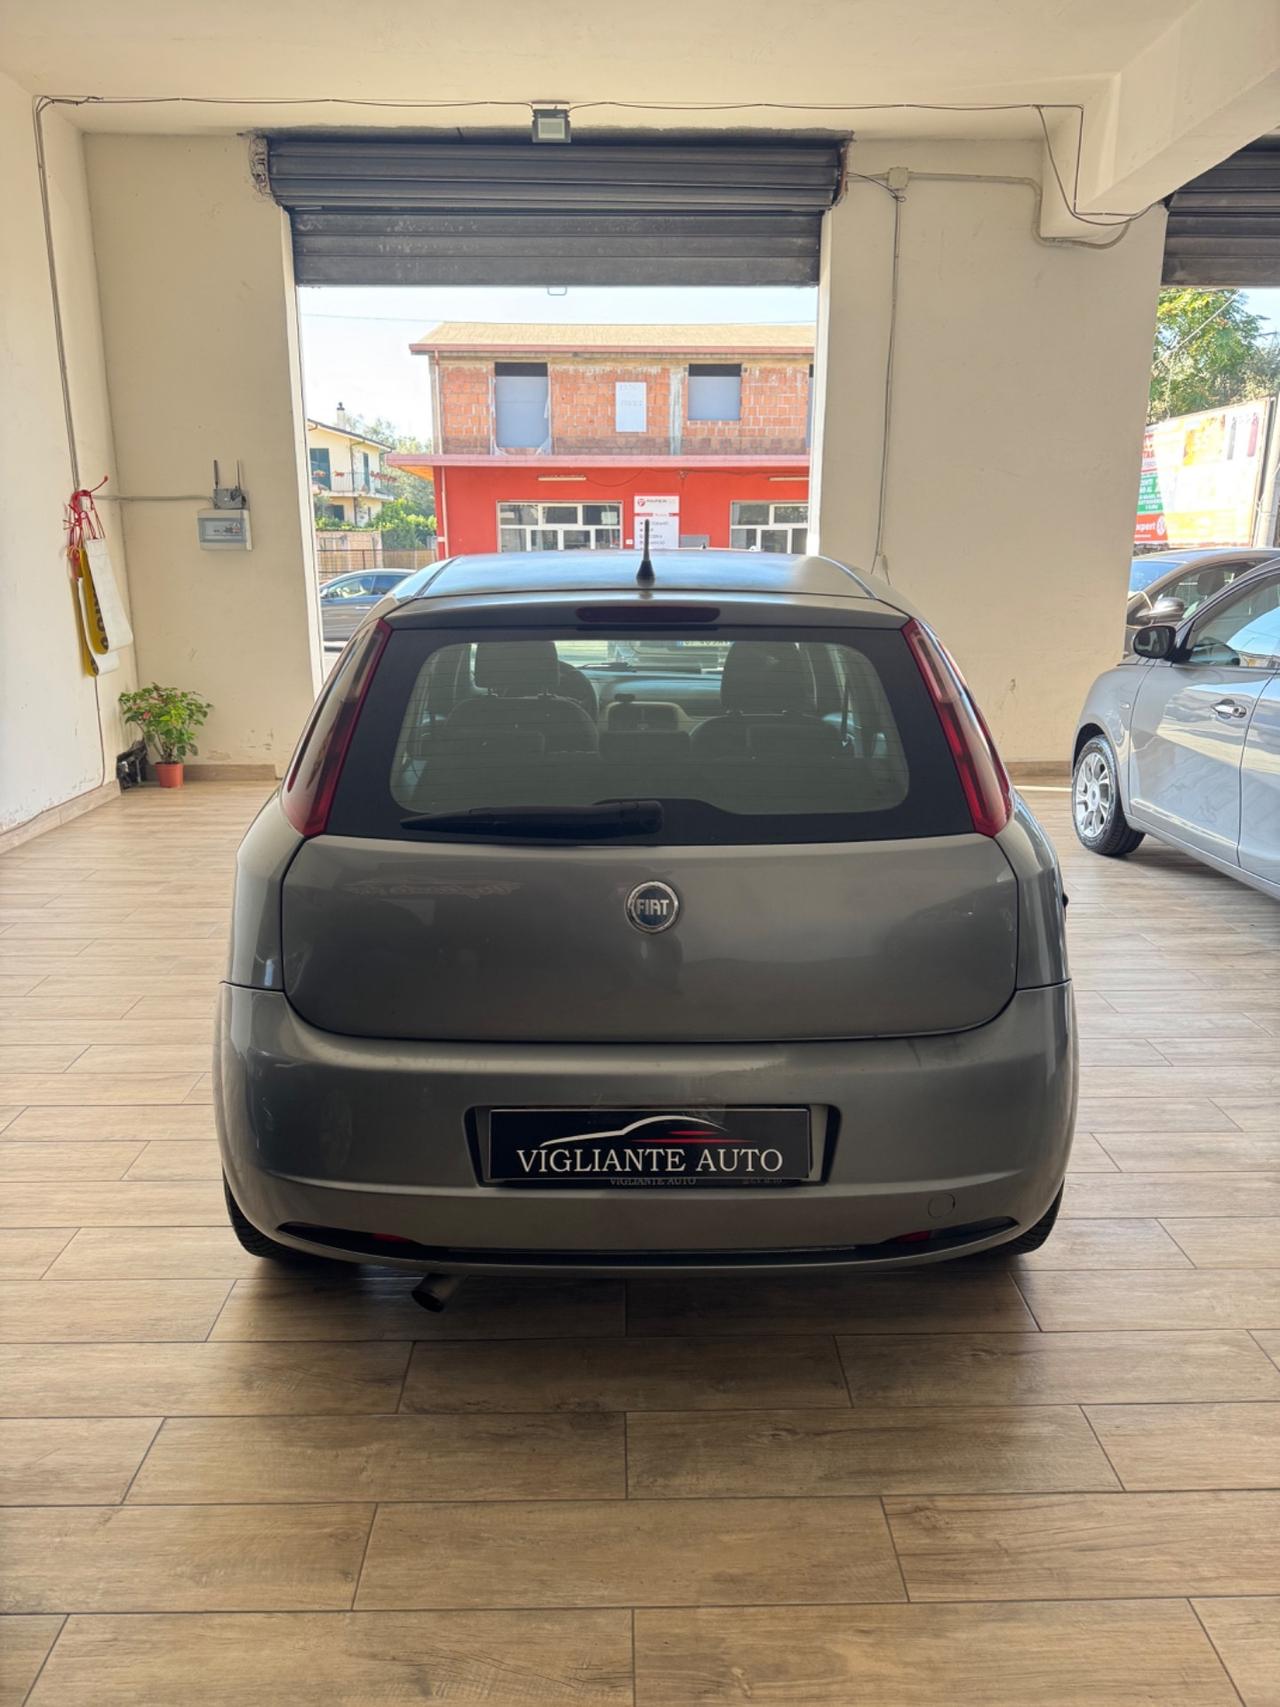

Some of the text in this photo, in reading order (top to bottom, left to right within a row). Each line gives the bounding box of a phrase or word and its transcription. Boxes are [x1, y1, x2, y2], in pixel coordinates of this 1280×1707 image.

[636, 899, 669, 915] FIAT
[516, 1148, 784, 1173] VIGLIANTE AUTO
